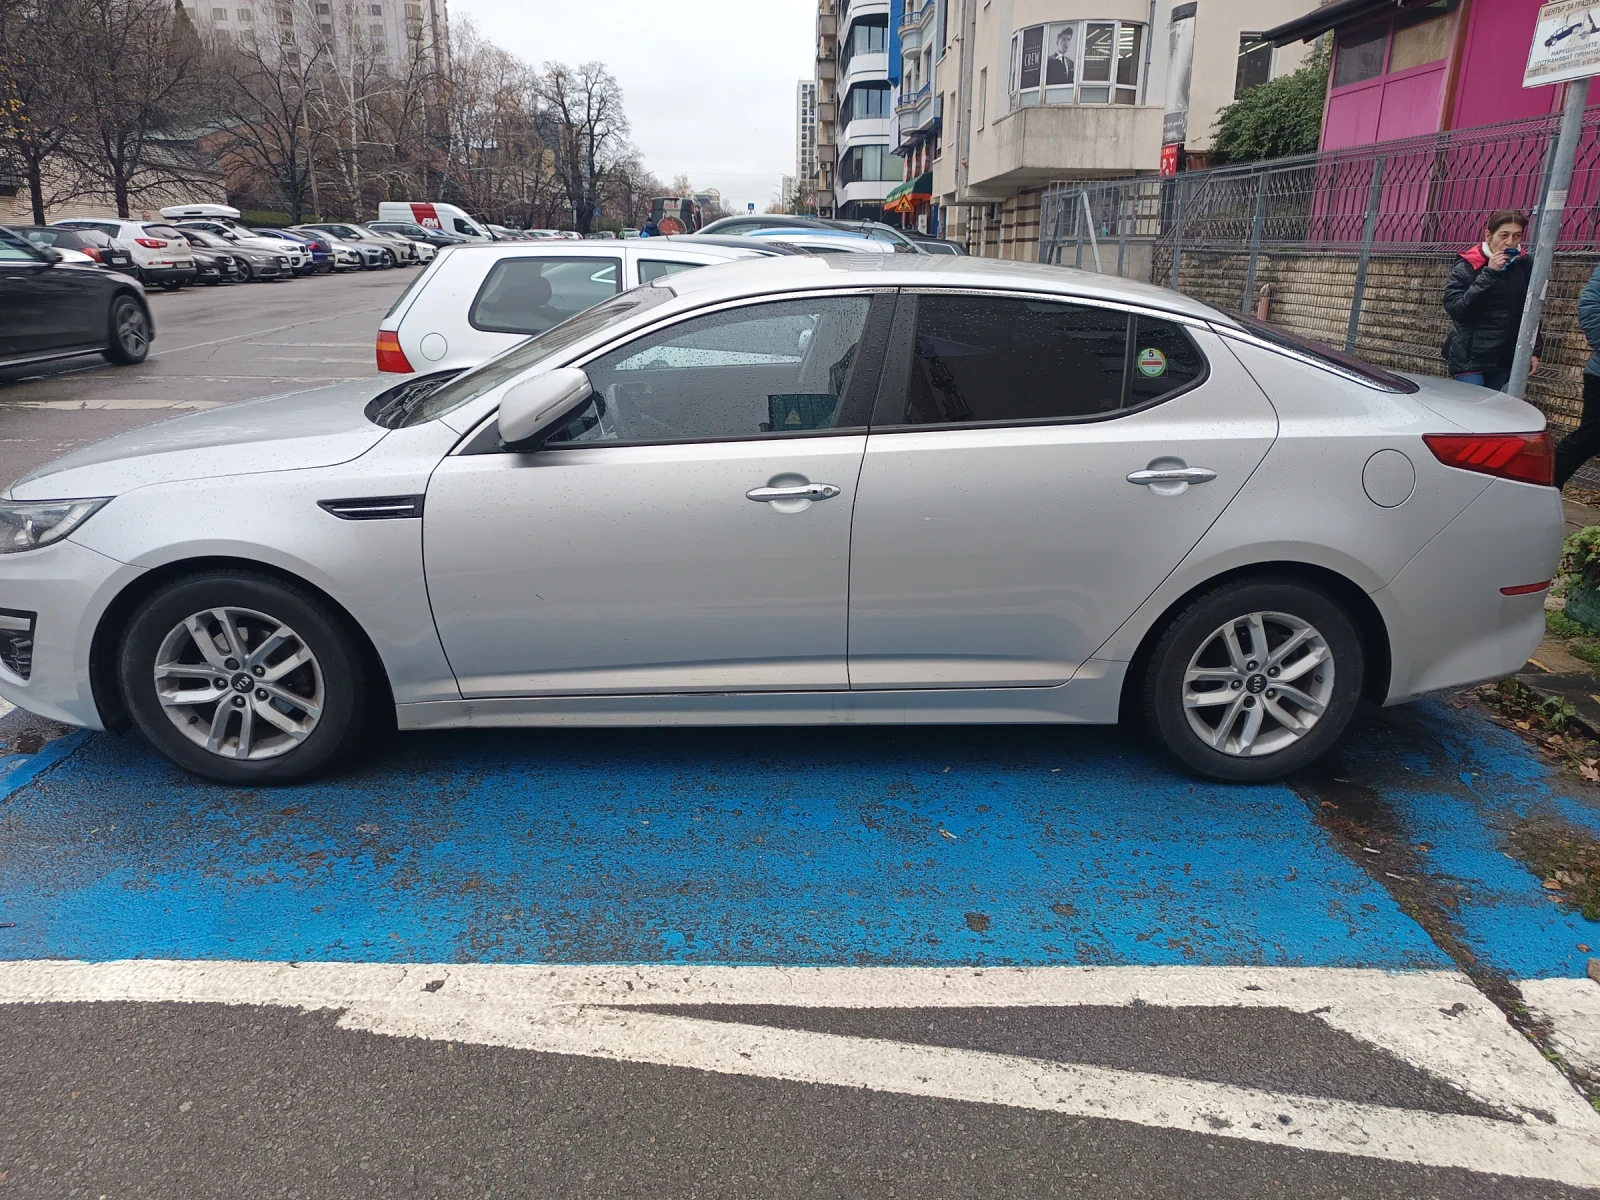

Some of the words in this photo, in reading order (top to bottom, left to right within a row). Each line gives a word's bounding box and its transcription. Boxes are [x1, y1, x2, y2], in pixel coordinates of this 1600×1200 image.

[1544, 5, 1566, 17] ЦЕНТЪР
[1148, 349, 1155, 358] 5
[234, 675, 251, 690] KIA
[1253, 676, 1261, 692] KIA
